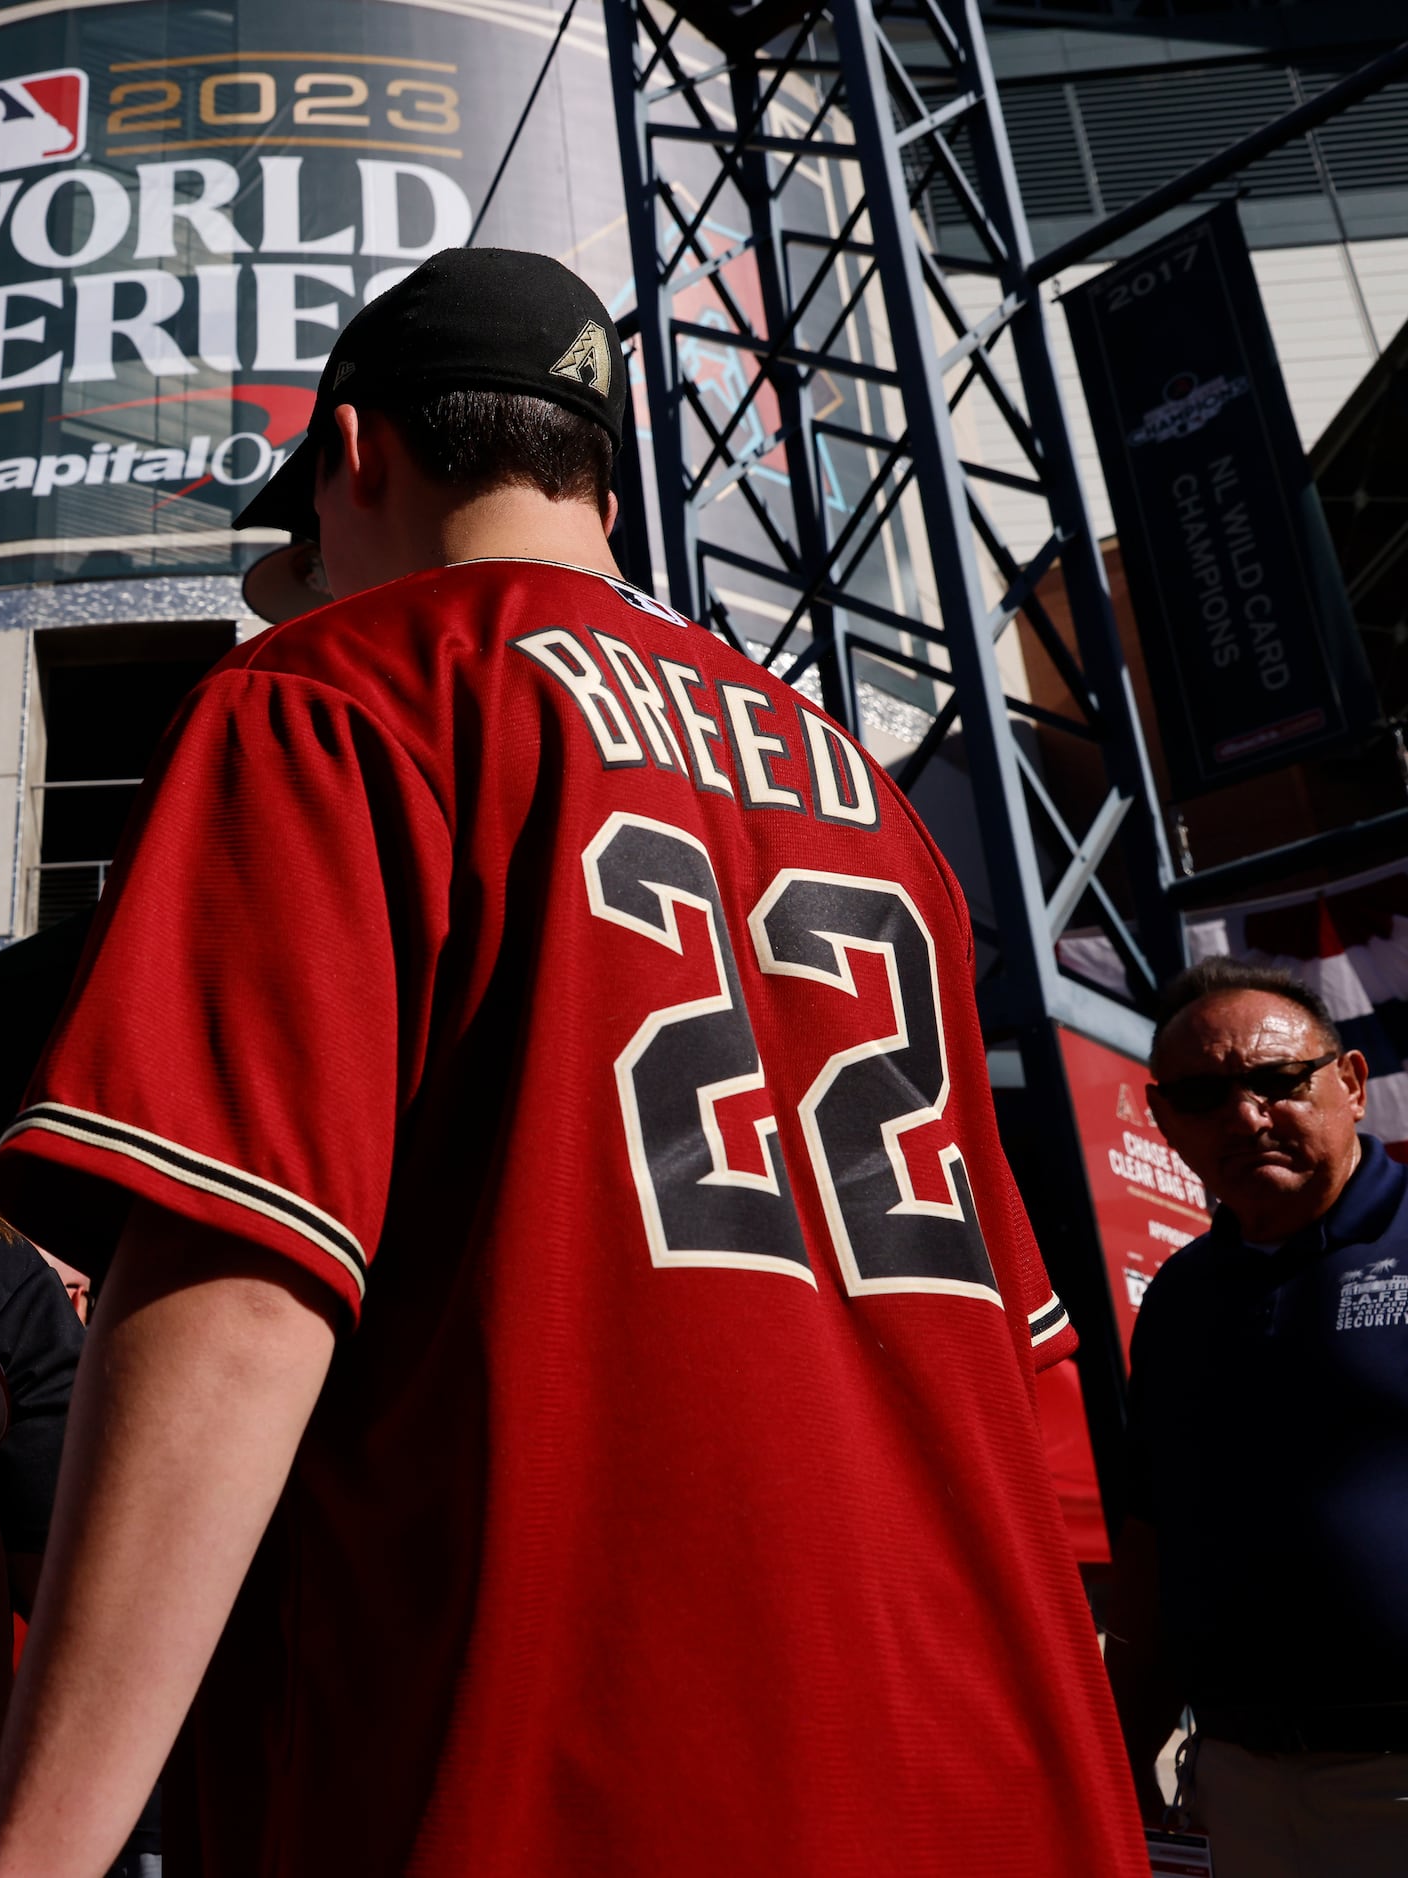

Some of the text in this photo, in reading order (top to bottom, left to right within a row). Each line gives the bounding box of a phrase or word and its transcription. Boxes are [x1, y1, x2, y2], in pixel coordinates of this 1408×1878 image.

[106, 72, 460, 135] 2023
[1106, 244, 1201, 313] 2017
[1171, 472, 1241, 670] CHAMPIONS
[1208, 453, 1293, 692] NL WILD CARD
[506, 626, 882, 832] BREED
[580, 811, 1004, 1312] 22
[1107, 1148, 1157, 1189] CLEAR
[1154, 1167, 1187, 1201] BAG
[1184, 1180, 1208, 1210] PO
[1122, 1130, 1173, 1172] CHASE
